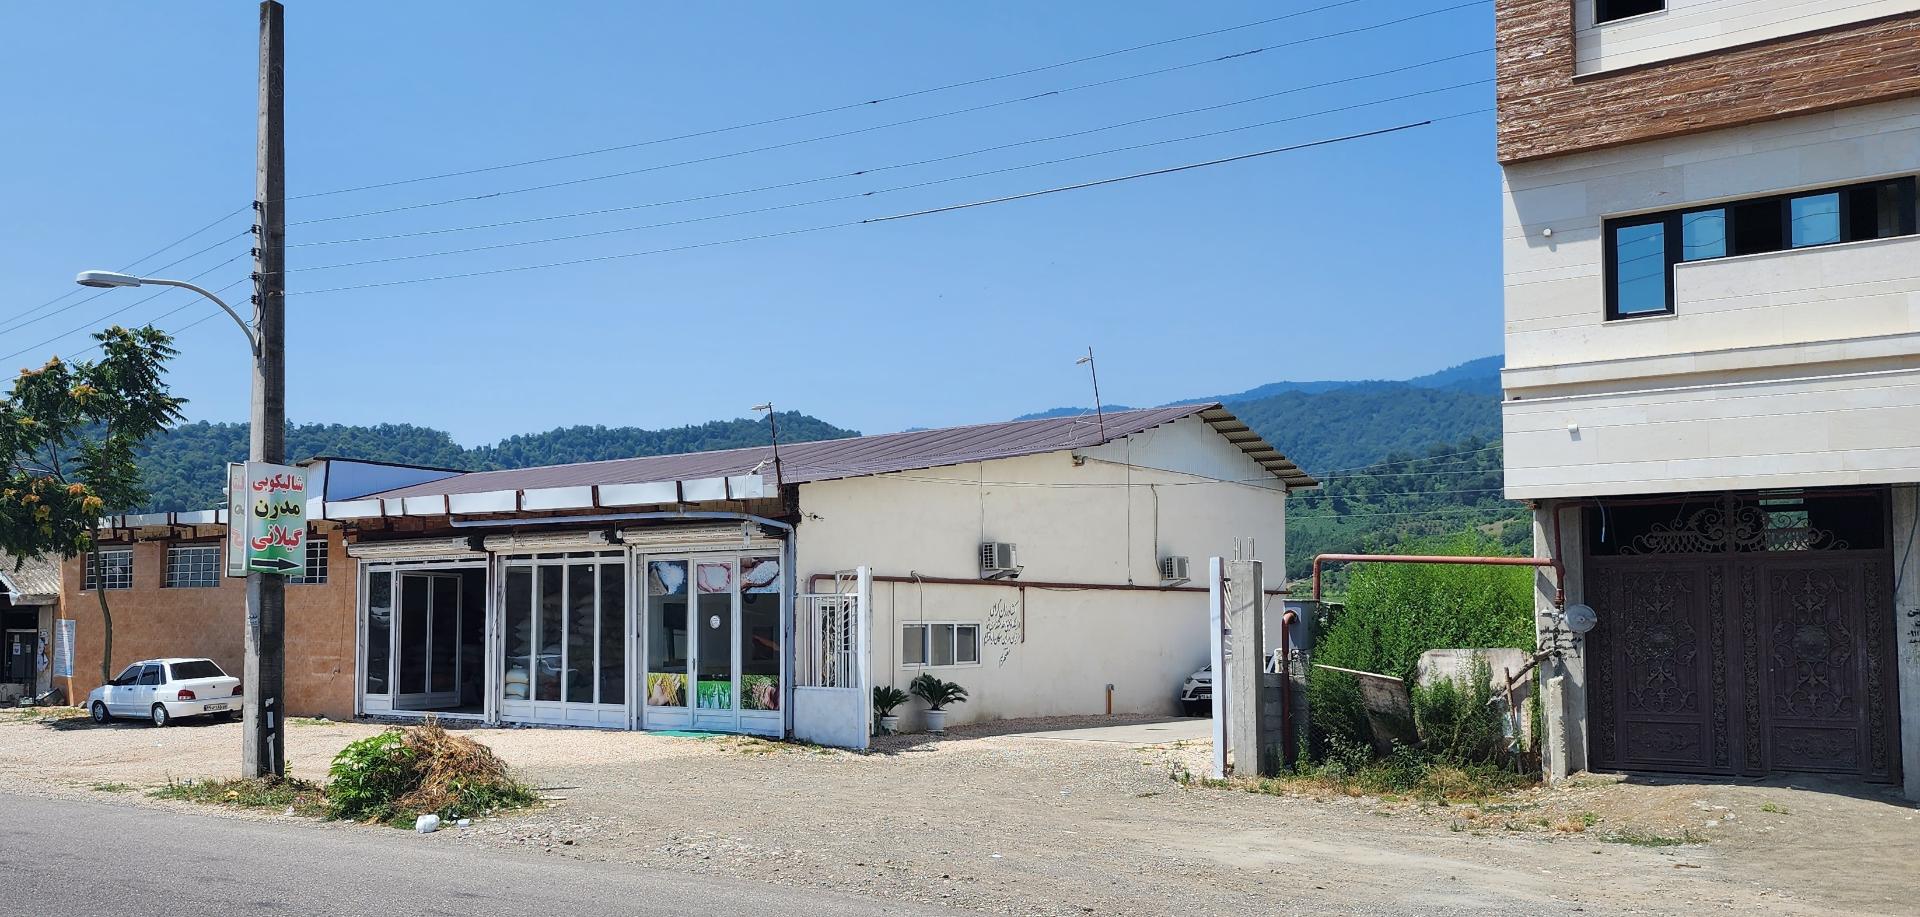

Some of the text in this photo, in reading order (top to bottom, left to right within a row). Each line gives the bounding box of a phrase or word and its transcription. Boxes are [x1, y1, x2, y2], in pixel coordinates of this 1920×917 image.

[252, 473, 304, 493] شالیکوبی
[254, 500, 301, 518] مدرن
[251, 525, 303, 551] گیلانی
